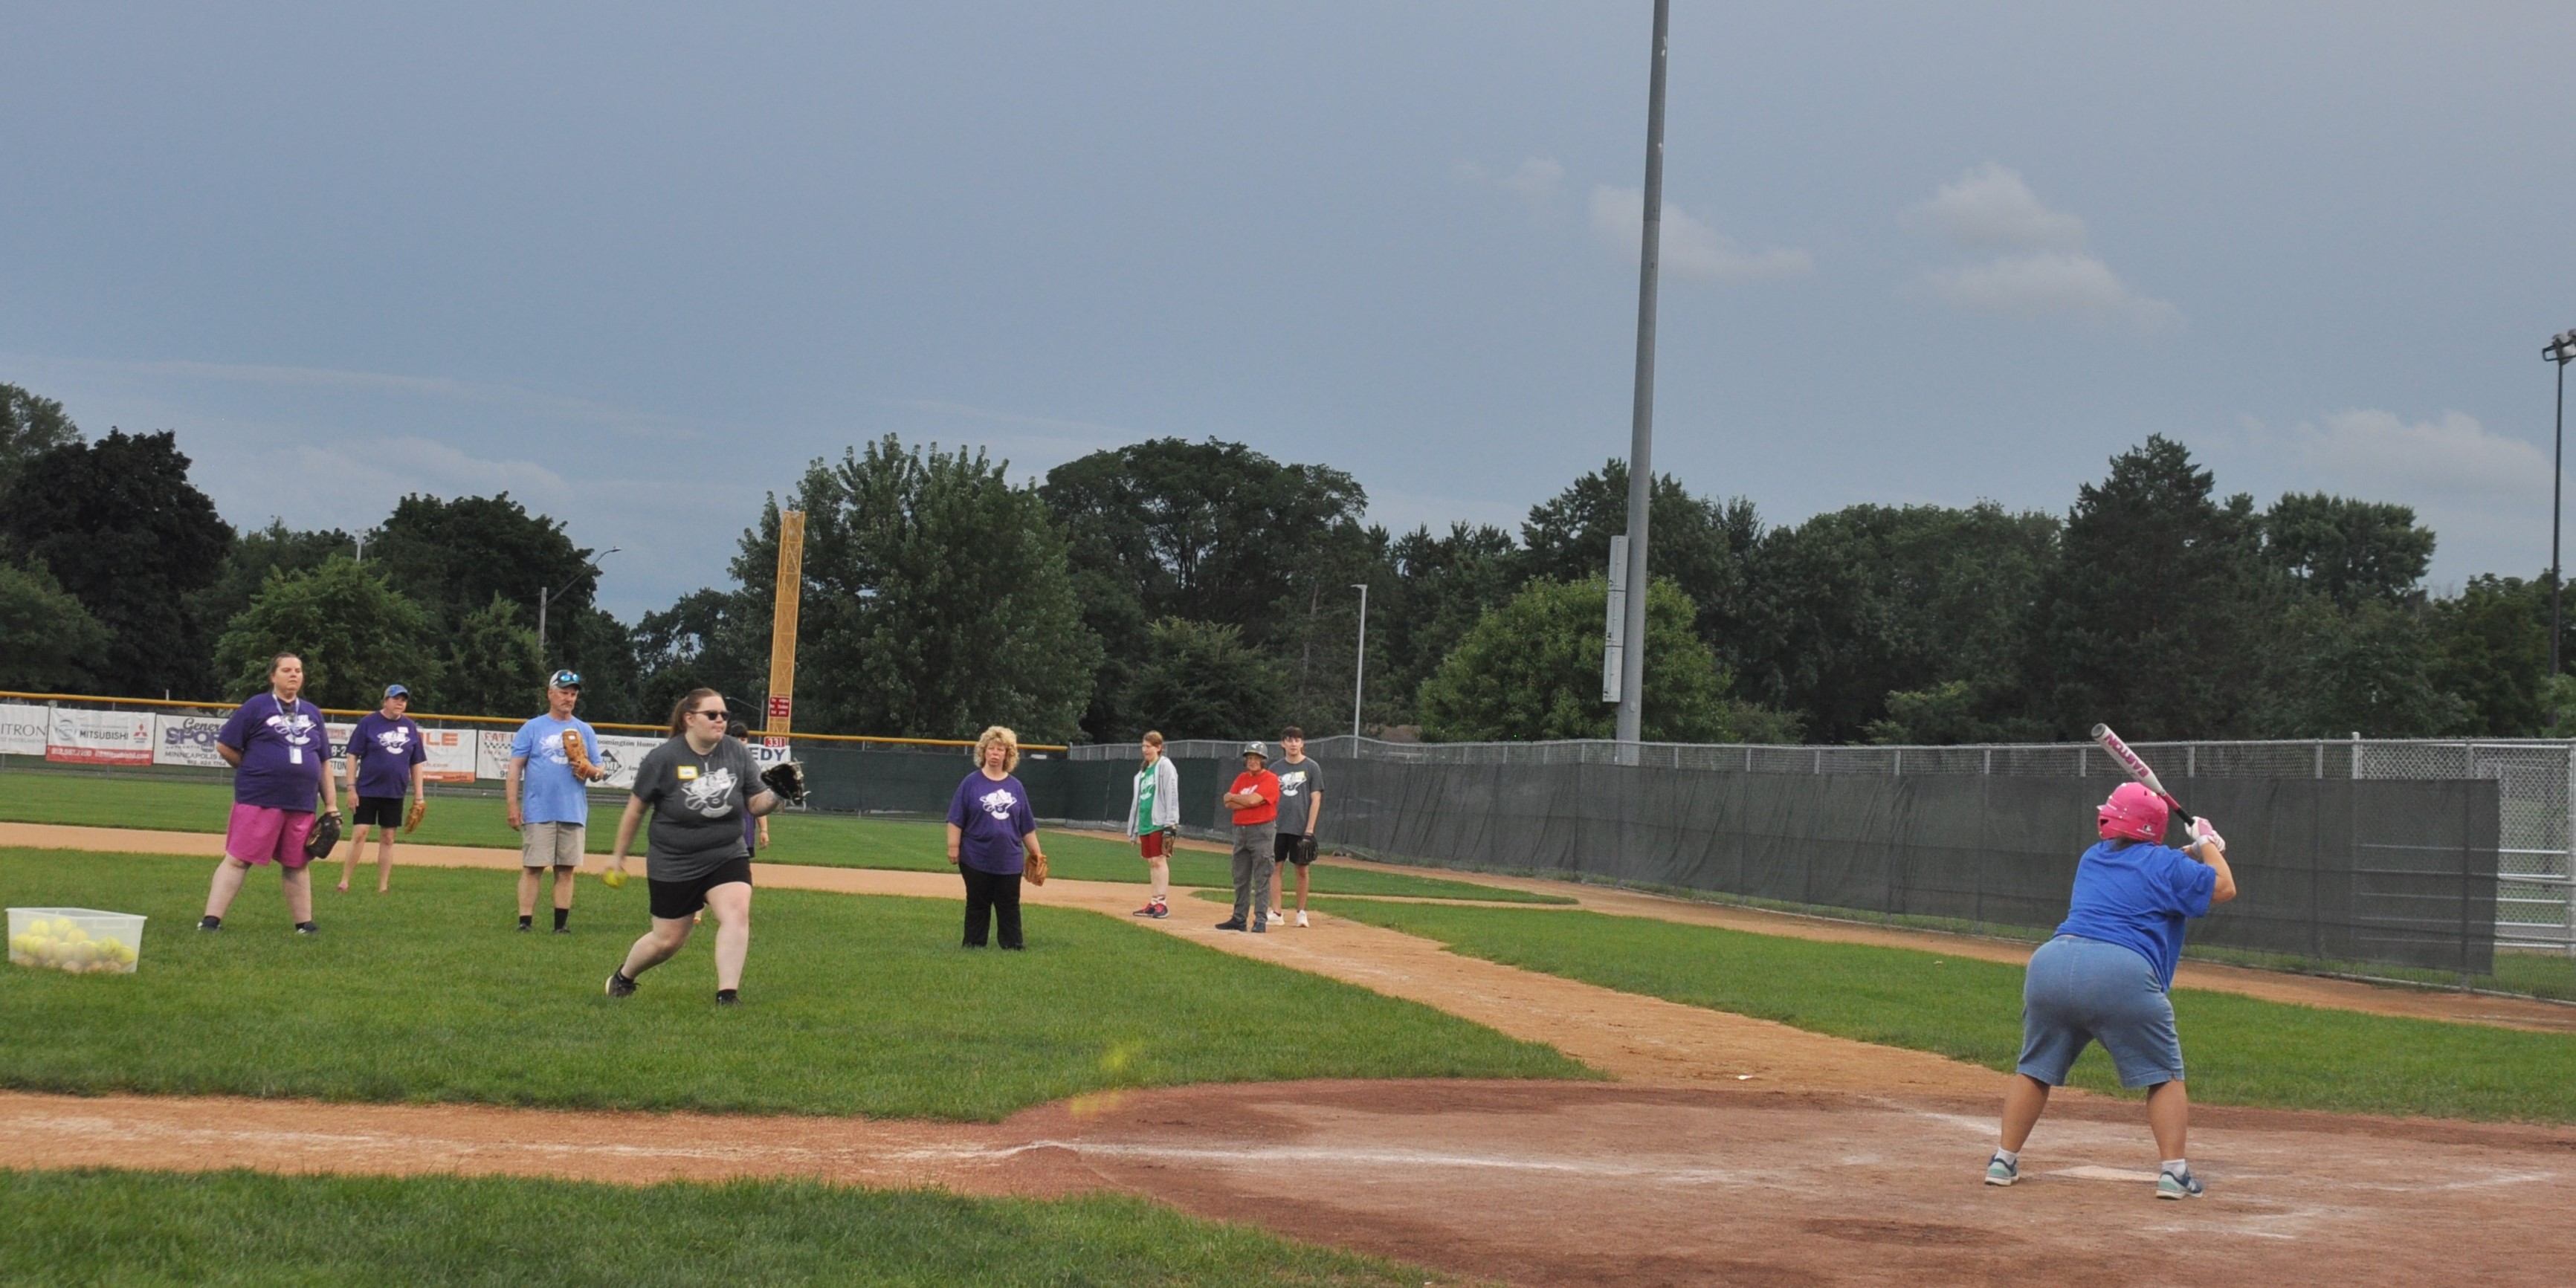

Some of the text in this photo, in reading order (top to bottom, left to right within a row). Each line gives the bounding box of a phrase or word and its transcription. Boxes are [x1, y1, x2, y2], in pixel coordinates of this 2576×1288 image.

[183, 718, 221, 732] Gener
[80, 729, 129, 740] MITSUBISHI
[165, 728, 220, 745] SPOR
[597, 740, 635, 748] oomington
[768, 738, 783, 747] 331
[165, 751, 218, 760] MINNEAPOLIS
[2102, 733, 2150, 778] EASTON
